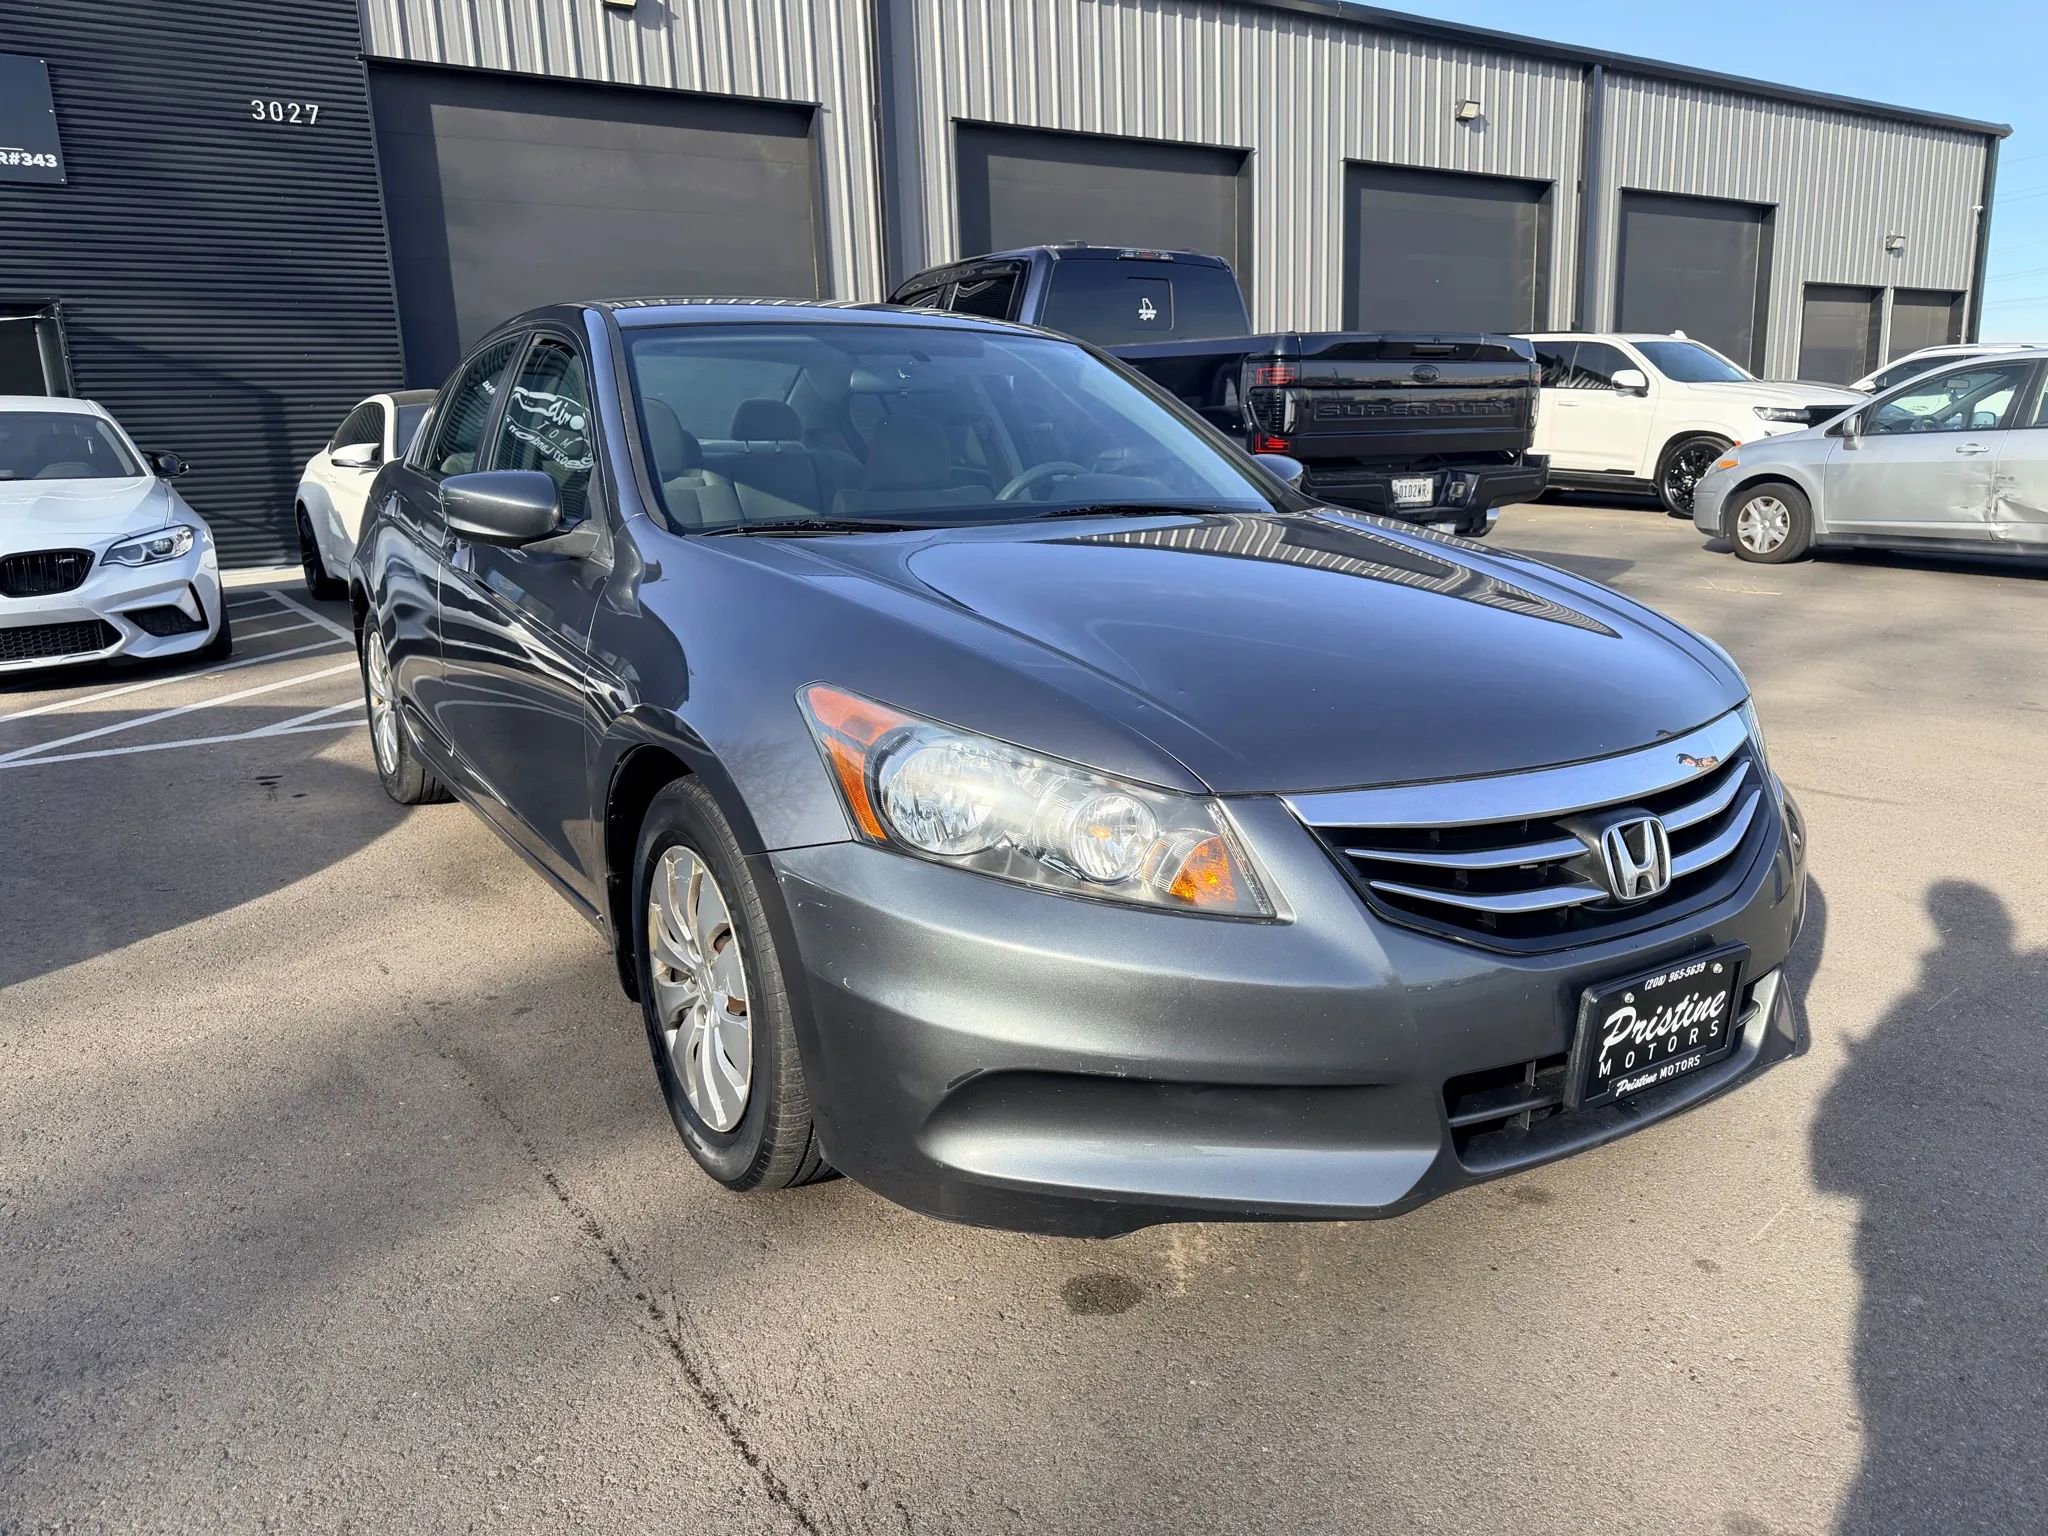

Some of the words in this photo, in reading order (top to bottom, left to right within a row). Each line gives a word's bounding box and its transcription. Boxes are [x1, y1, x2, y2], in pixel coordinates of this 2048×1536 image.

[251, 100, 318, 125] 3027
[1318, 403, 1430, 416] SUPER
[1437, 401, 1513, 414] DUTY
[1645, 974, 1667, 991] (208)
[1668, 961, 1707, 983] 965-5639
[1599, 991, 1727, 1062] Pristine
[1599, 1020, 1719, 1078] MOTORS
[1616, 1073, 1657, 1097] Pristine
[1659, 1054, 1701, 1079] MOTORS
